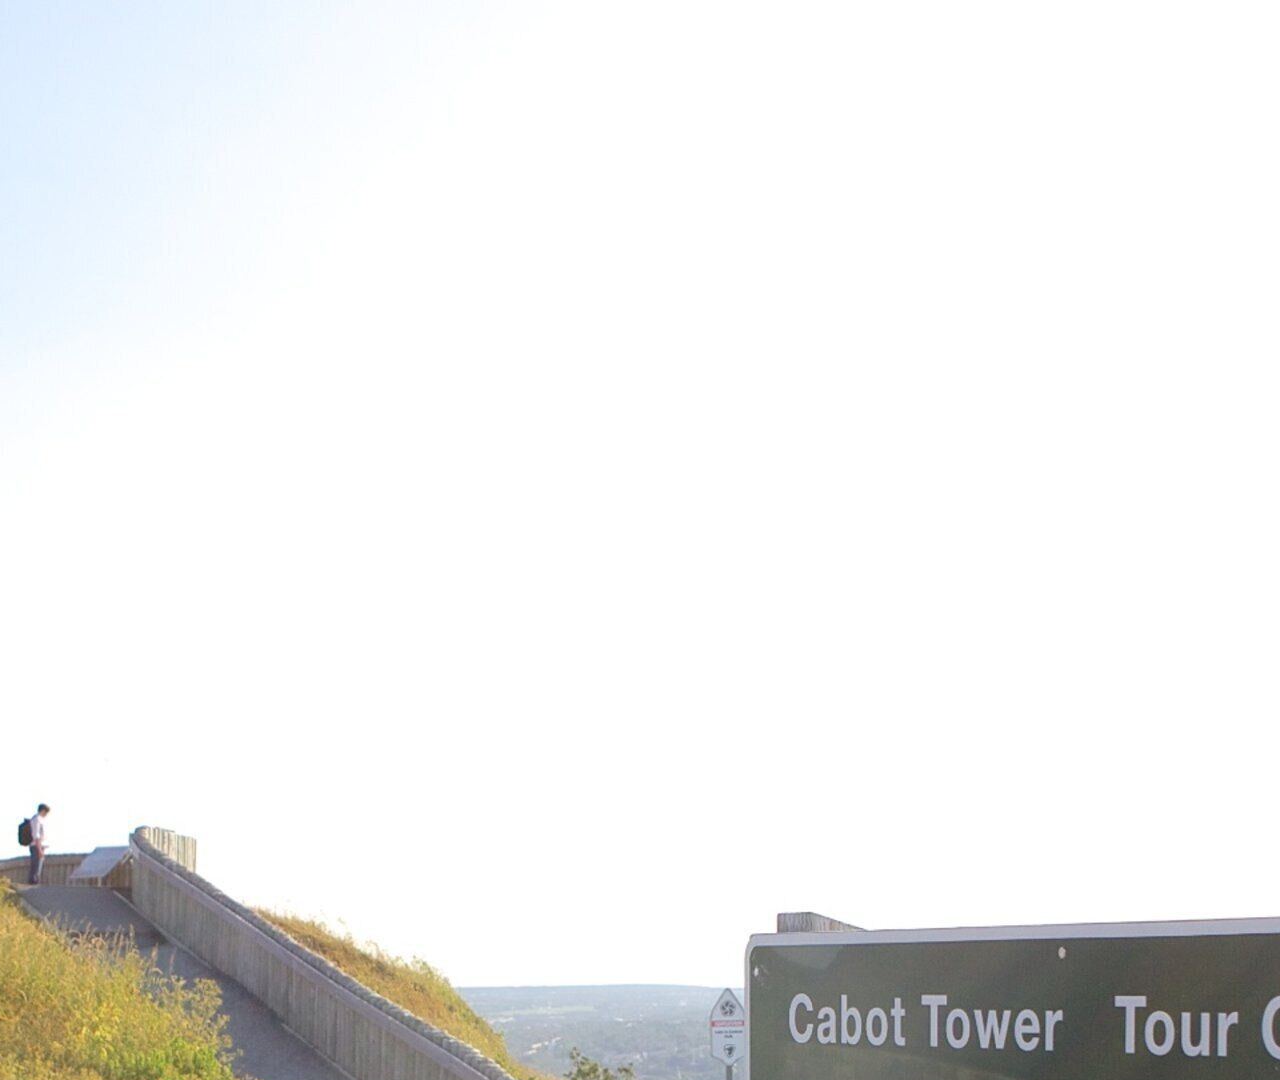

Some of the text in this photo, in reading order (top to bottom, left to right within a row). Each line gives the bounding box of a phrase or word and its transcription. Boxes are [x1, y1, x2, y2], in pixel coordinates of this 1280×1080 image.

[789, 993, 1063, 1051] Cabot Tower
[1114, 995, 1239, 1056] Tour
